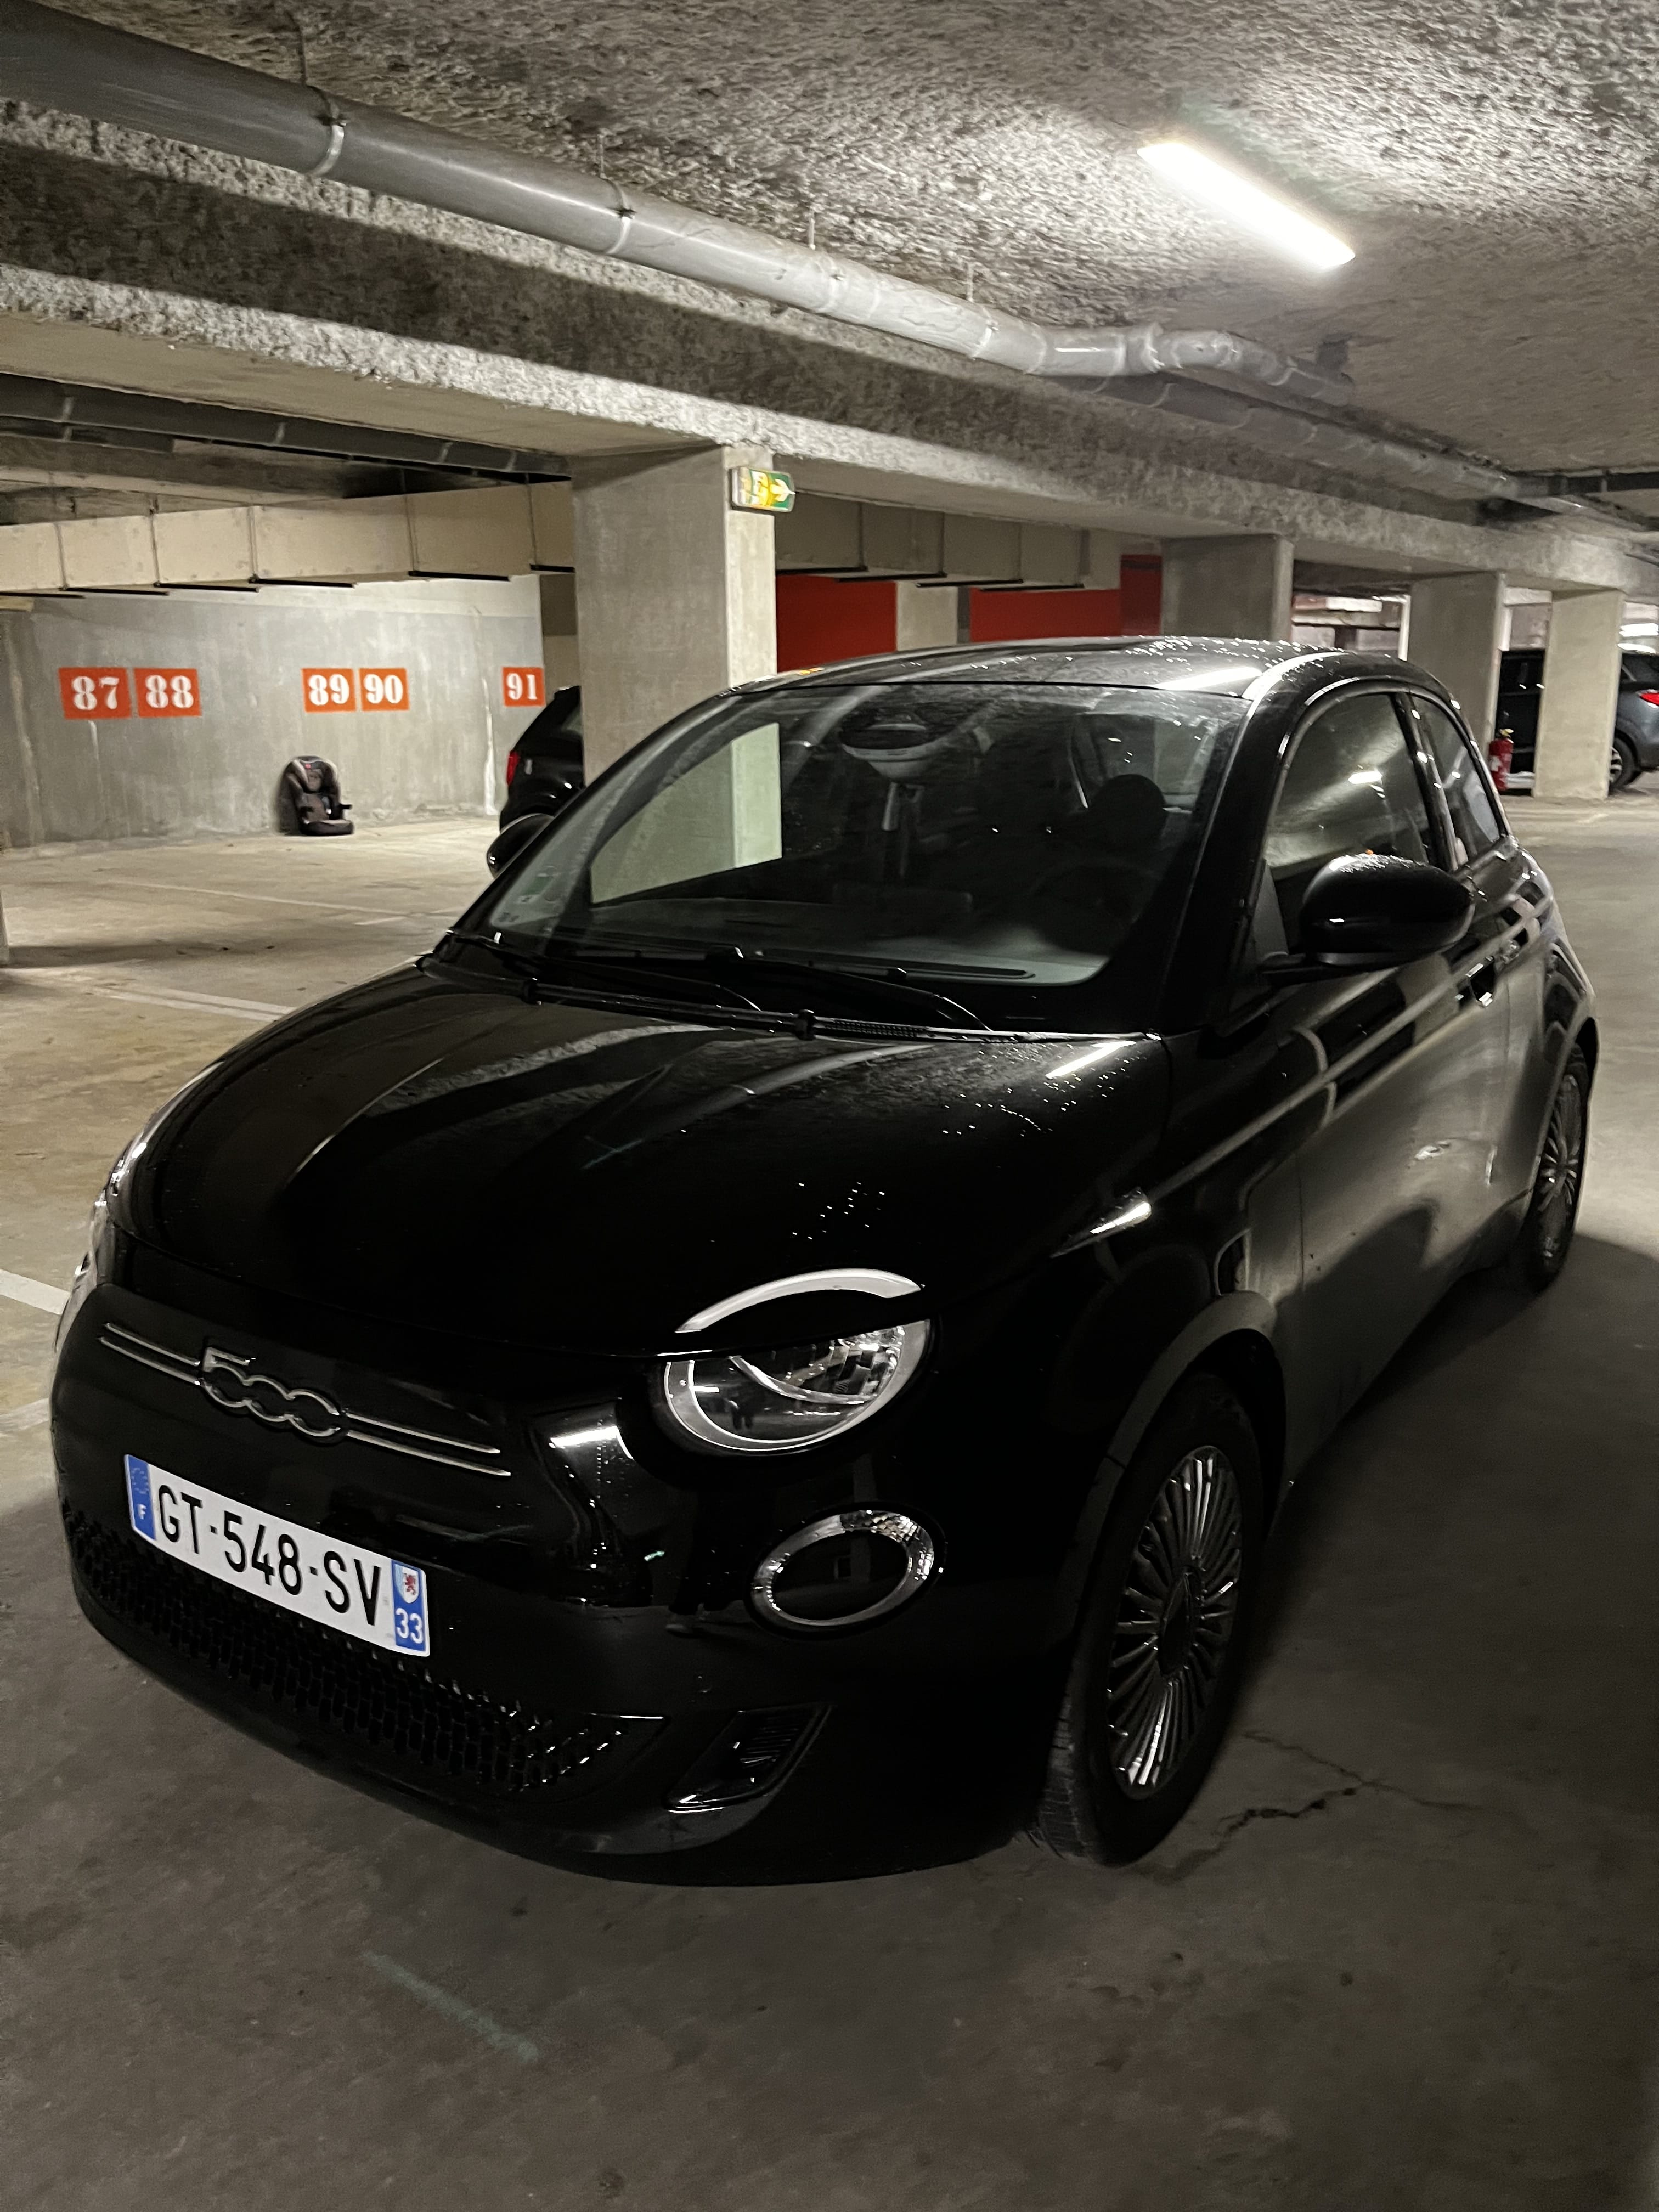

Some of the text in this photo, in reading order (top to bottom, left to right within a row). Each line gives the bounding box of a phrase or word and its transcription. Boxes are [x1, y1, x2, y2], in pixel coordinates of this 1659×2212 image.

[72, 675, 120, 710] 87
[145, 675, 194, 708] 88
[308, 674, 349, 706] 89
[364, 674, 403, 704] 90
[506, 673, 538, 700] 91
[200, 1347, 341, 1437] 500
[137, 1504, 147, 1520] F
[158, 1485, 381, 1626] GT-548-SV
[396, 1607, 424, 1644] 33
